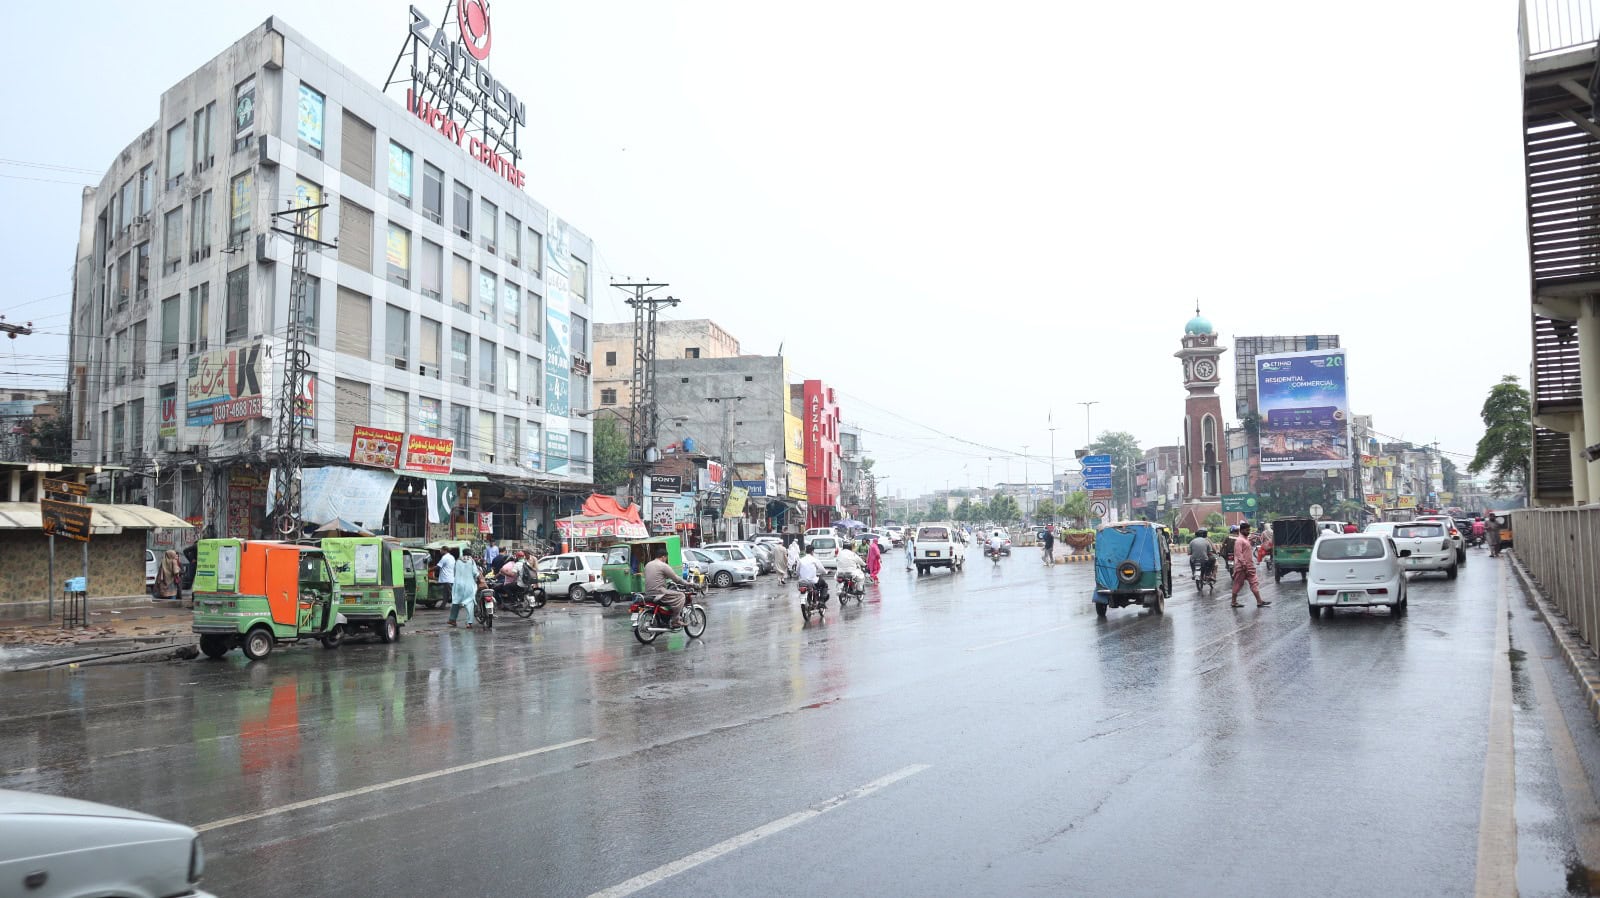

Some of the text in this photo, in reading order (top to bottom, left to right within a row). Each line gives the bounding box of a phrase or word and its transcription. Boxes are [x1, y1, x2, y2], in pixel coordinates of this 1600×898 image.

[409, 4, 525, 127] ZAITOON
[407, 87, 466, 149] LUCKY
[470, 137, 525, 188] CENTRE
[228, 343, 261, 399] UK
[1265, 375, 1303, 384] RESIDENTIAL
[1291, 379, 1334, 388] COMMERCIAL
[747, 485, 762, 493] Print
